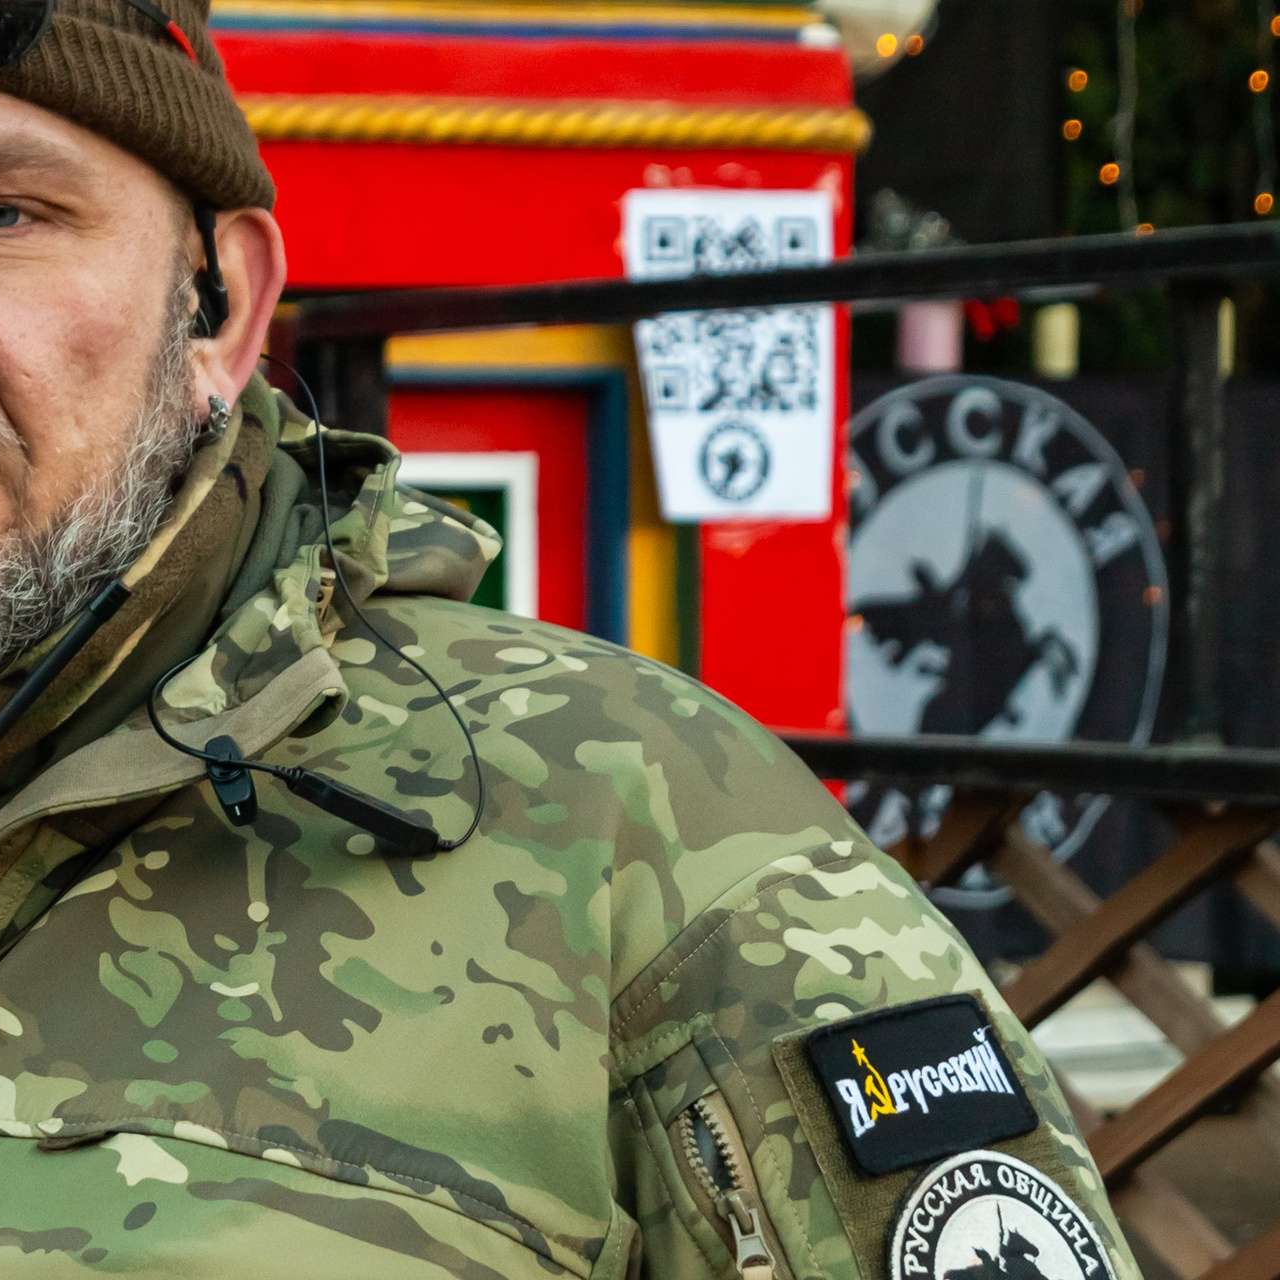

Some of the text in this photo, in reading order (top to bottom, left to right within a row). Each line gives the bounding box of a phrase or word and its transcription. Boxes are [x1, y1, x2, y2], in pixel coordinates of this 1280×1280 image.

[835, 1078, 876, 1138] Я
[903, 1163, 1100, 1277] РУССКАЯ ОБЩИНА
